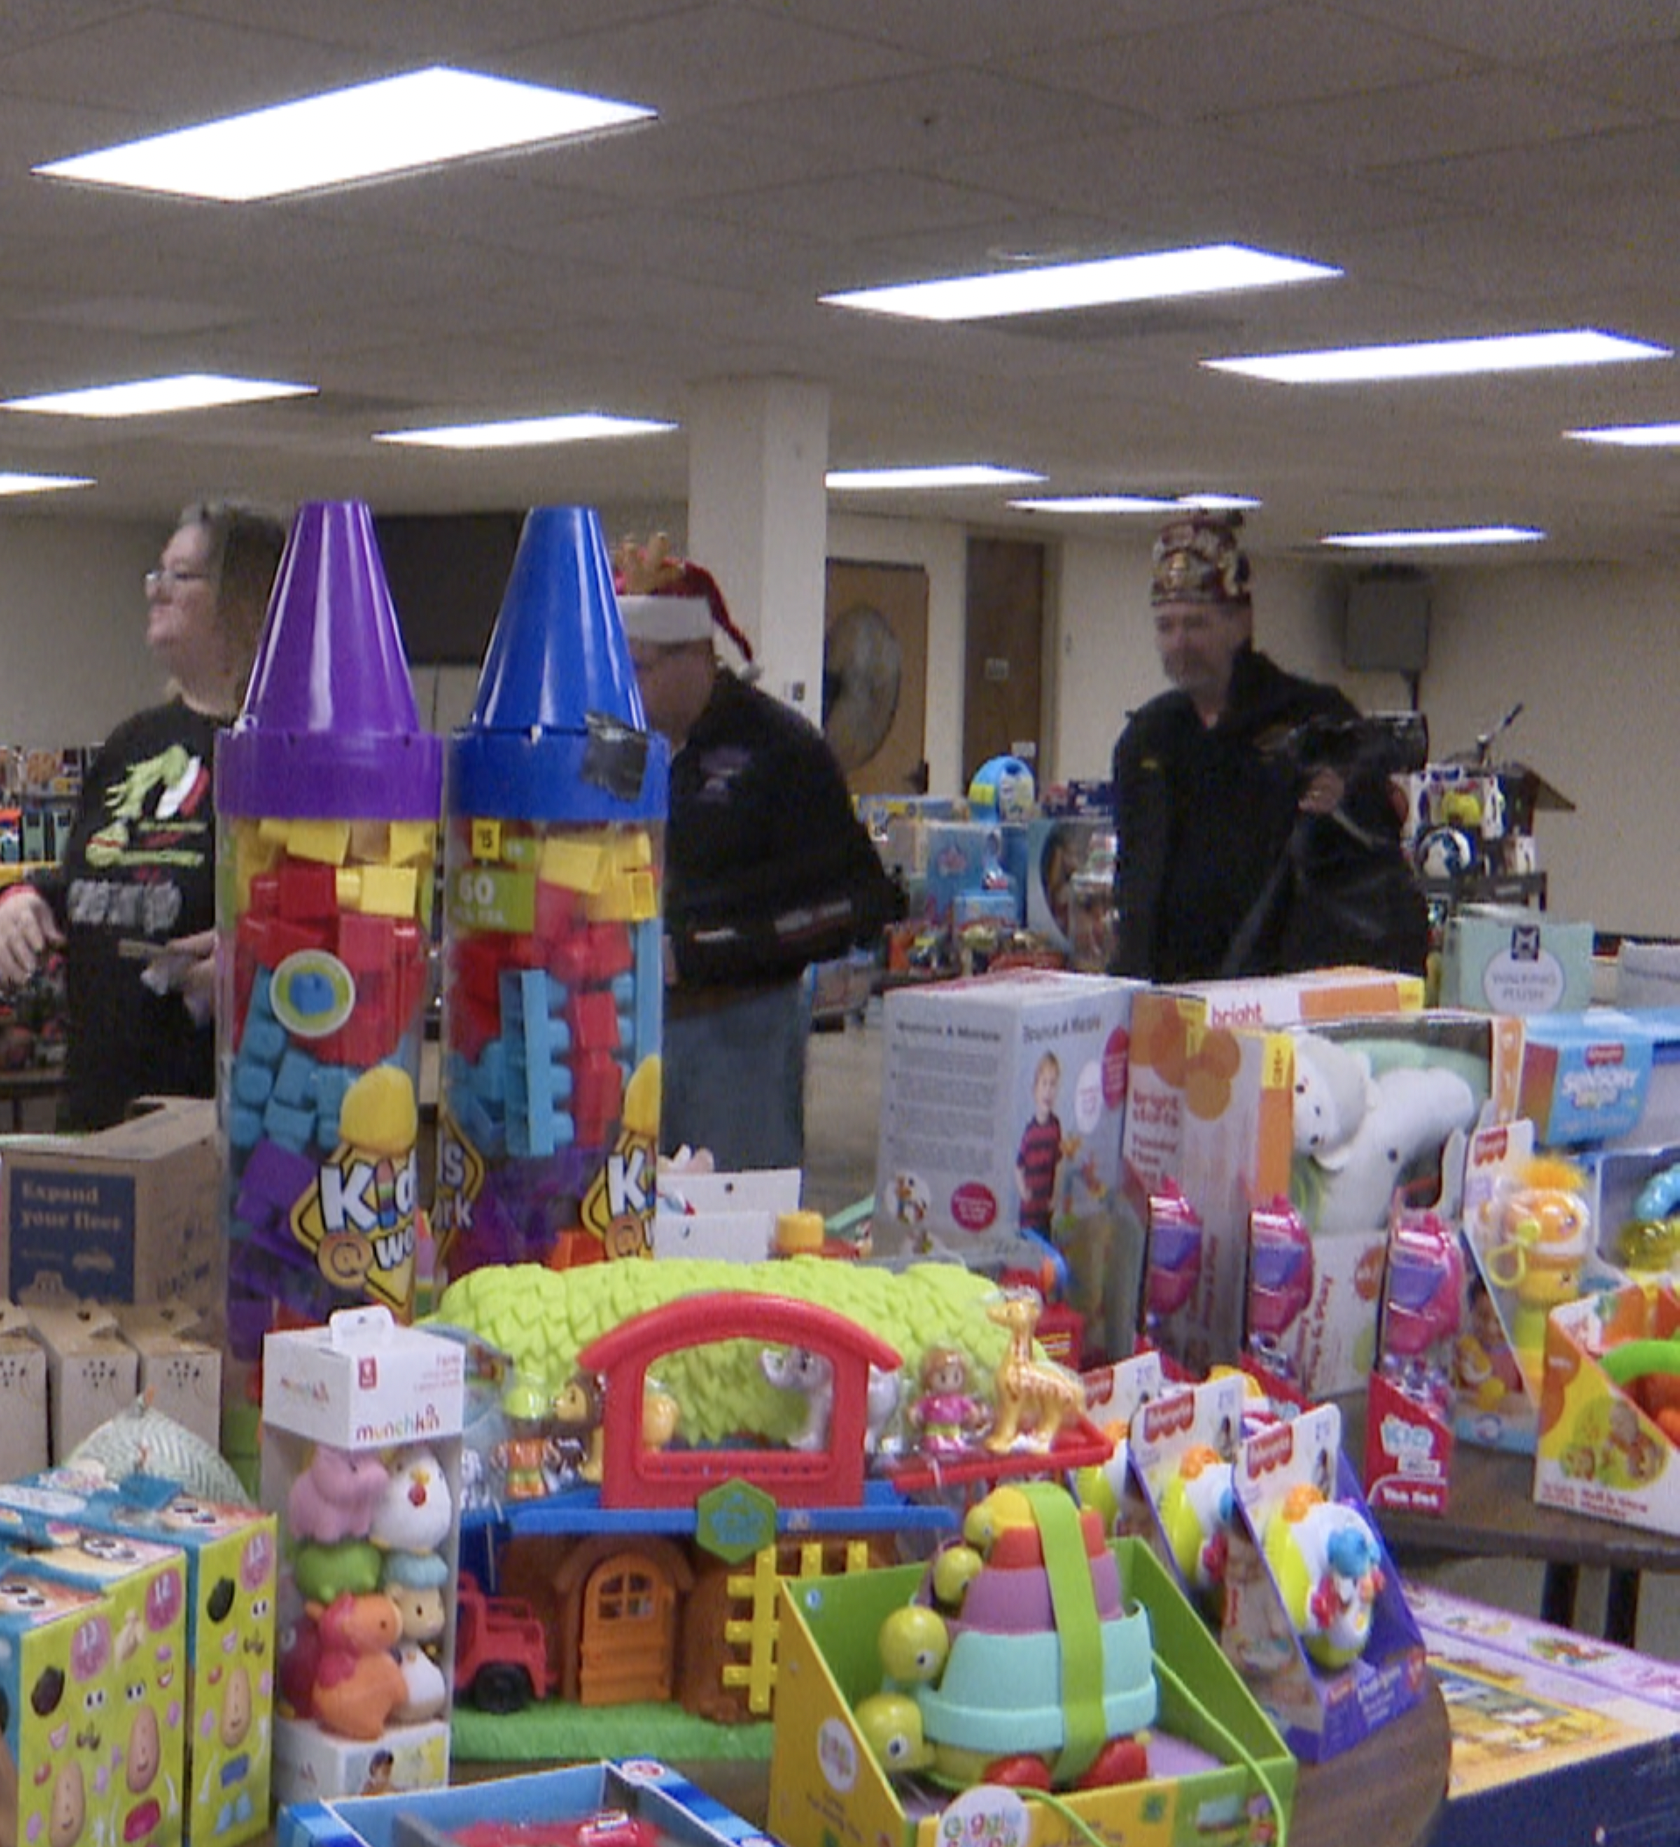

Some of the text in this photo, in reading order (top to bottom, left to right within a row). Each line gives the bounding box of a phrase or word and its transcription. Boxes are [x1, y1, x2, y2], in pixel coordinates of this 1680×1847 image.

[1212, 1003, 1263, 1030] bright
[22, 1181, 100, 1206] Expand
[320, 1148, 417, 1233] Kid
[22, 1211, 69, 1230] your
[374, 1227, 415, 1271] wo
[356, 1404, 440, 1443] munchkin
